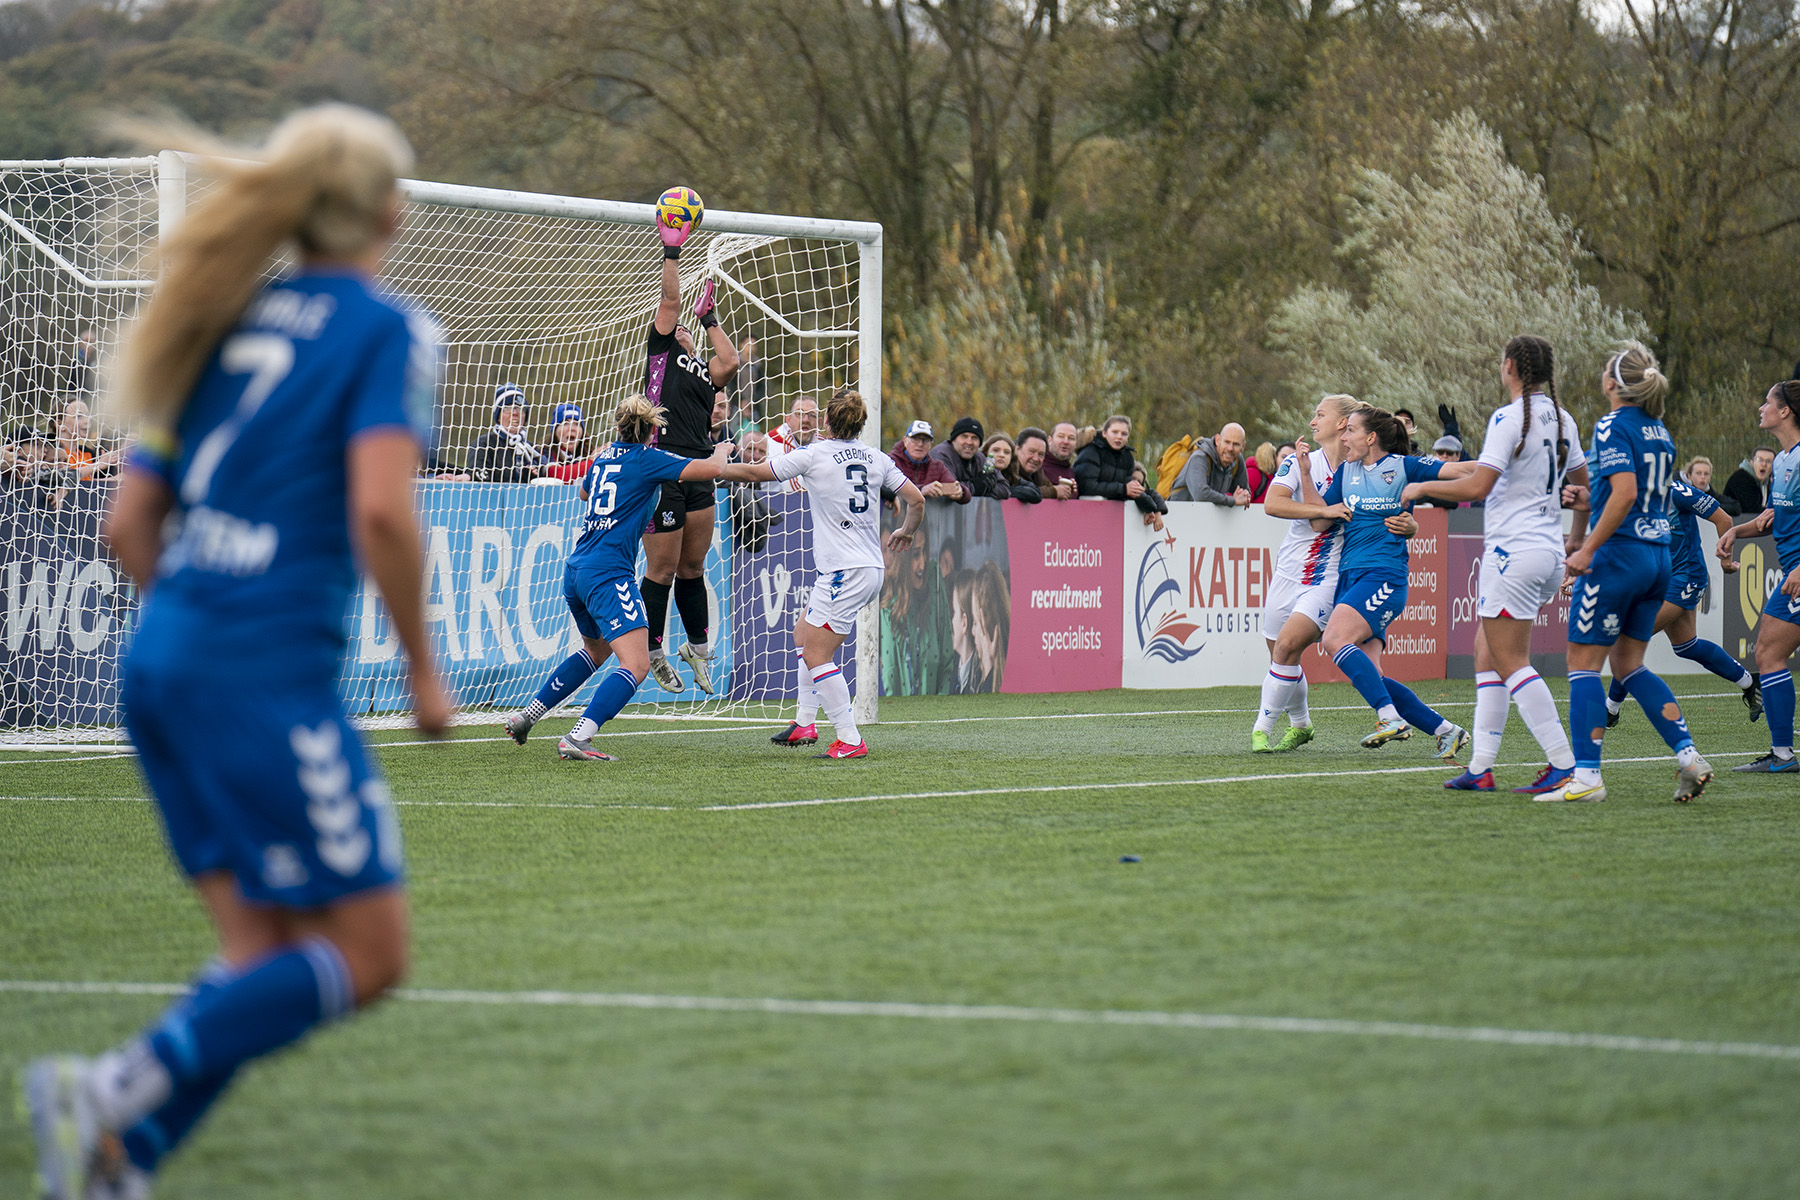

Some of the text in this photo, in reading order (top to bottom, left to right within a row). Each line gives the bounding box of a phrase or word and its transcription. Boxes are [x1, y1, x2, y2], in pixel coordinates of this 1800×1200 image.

[676, 354, 716, 392] cinc
[178, 332, 296, 506] 7
[832, 447, 874, 465] GIBBONS
[586, 464, 623, 517] 15
[845, 464, 870, 514] 3
[1361, 502, 1402, 511] EDUCATION
[1043, 541, 1102, 567] Education
[1405, 534, 1438, 559] ansport
[1408, 567, 1437, 592] ousing
[1031, 583, 1102, 609] recruitment
[1206, 613, 1265, 633] LOGIST
[1396, 600, 1437, 626] warding
[1041, 625, 1102, 656] specialists
[1387, 634, 1437, 656] Distribution
